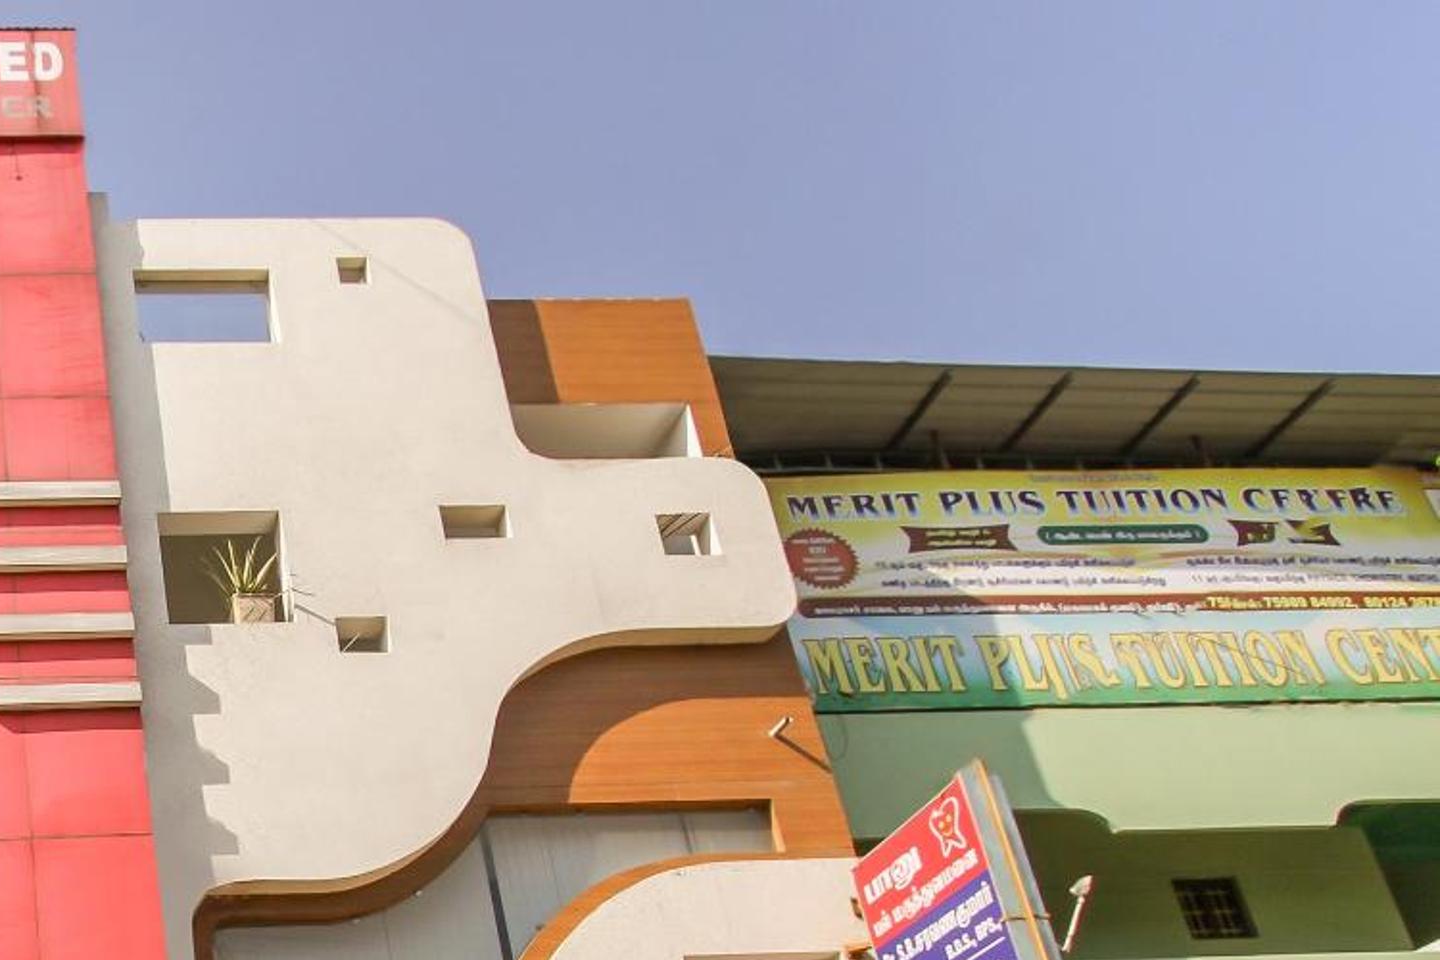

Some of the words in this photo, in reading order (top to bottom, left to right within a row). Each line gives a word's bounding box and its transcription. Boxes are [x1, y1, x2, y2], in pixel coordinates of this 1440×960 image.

[786, 491, 920, 521] MERIT
[938, 489, 1046, 518] PLUS
[1056, 487, 1229, 516] TUITION
[803, 634, 967, 696] MERIT
